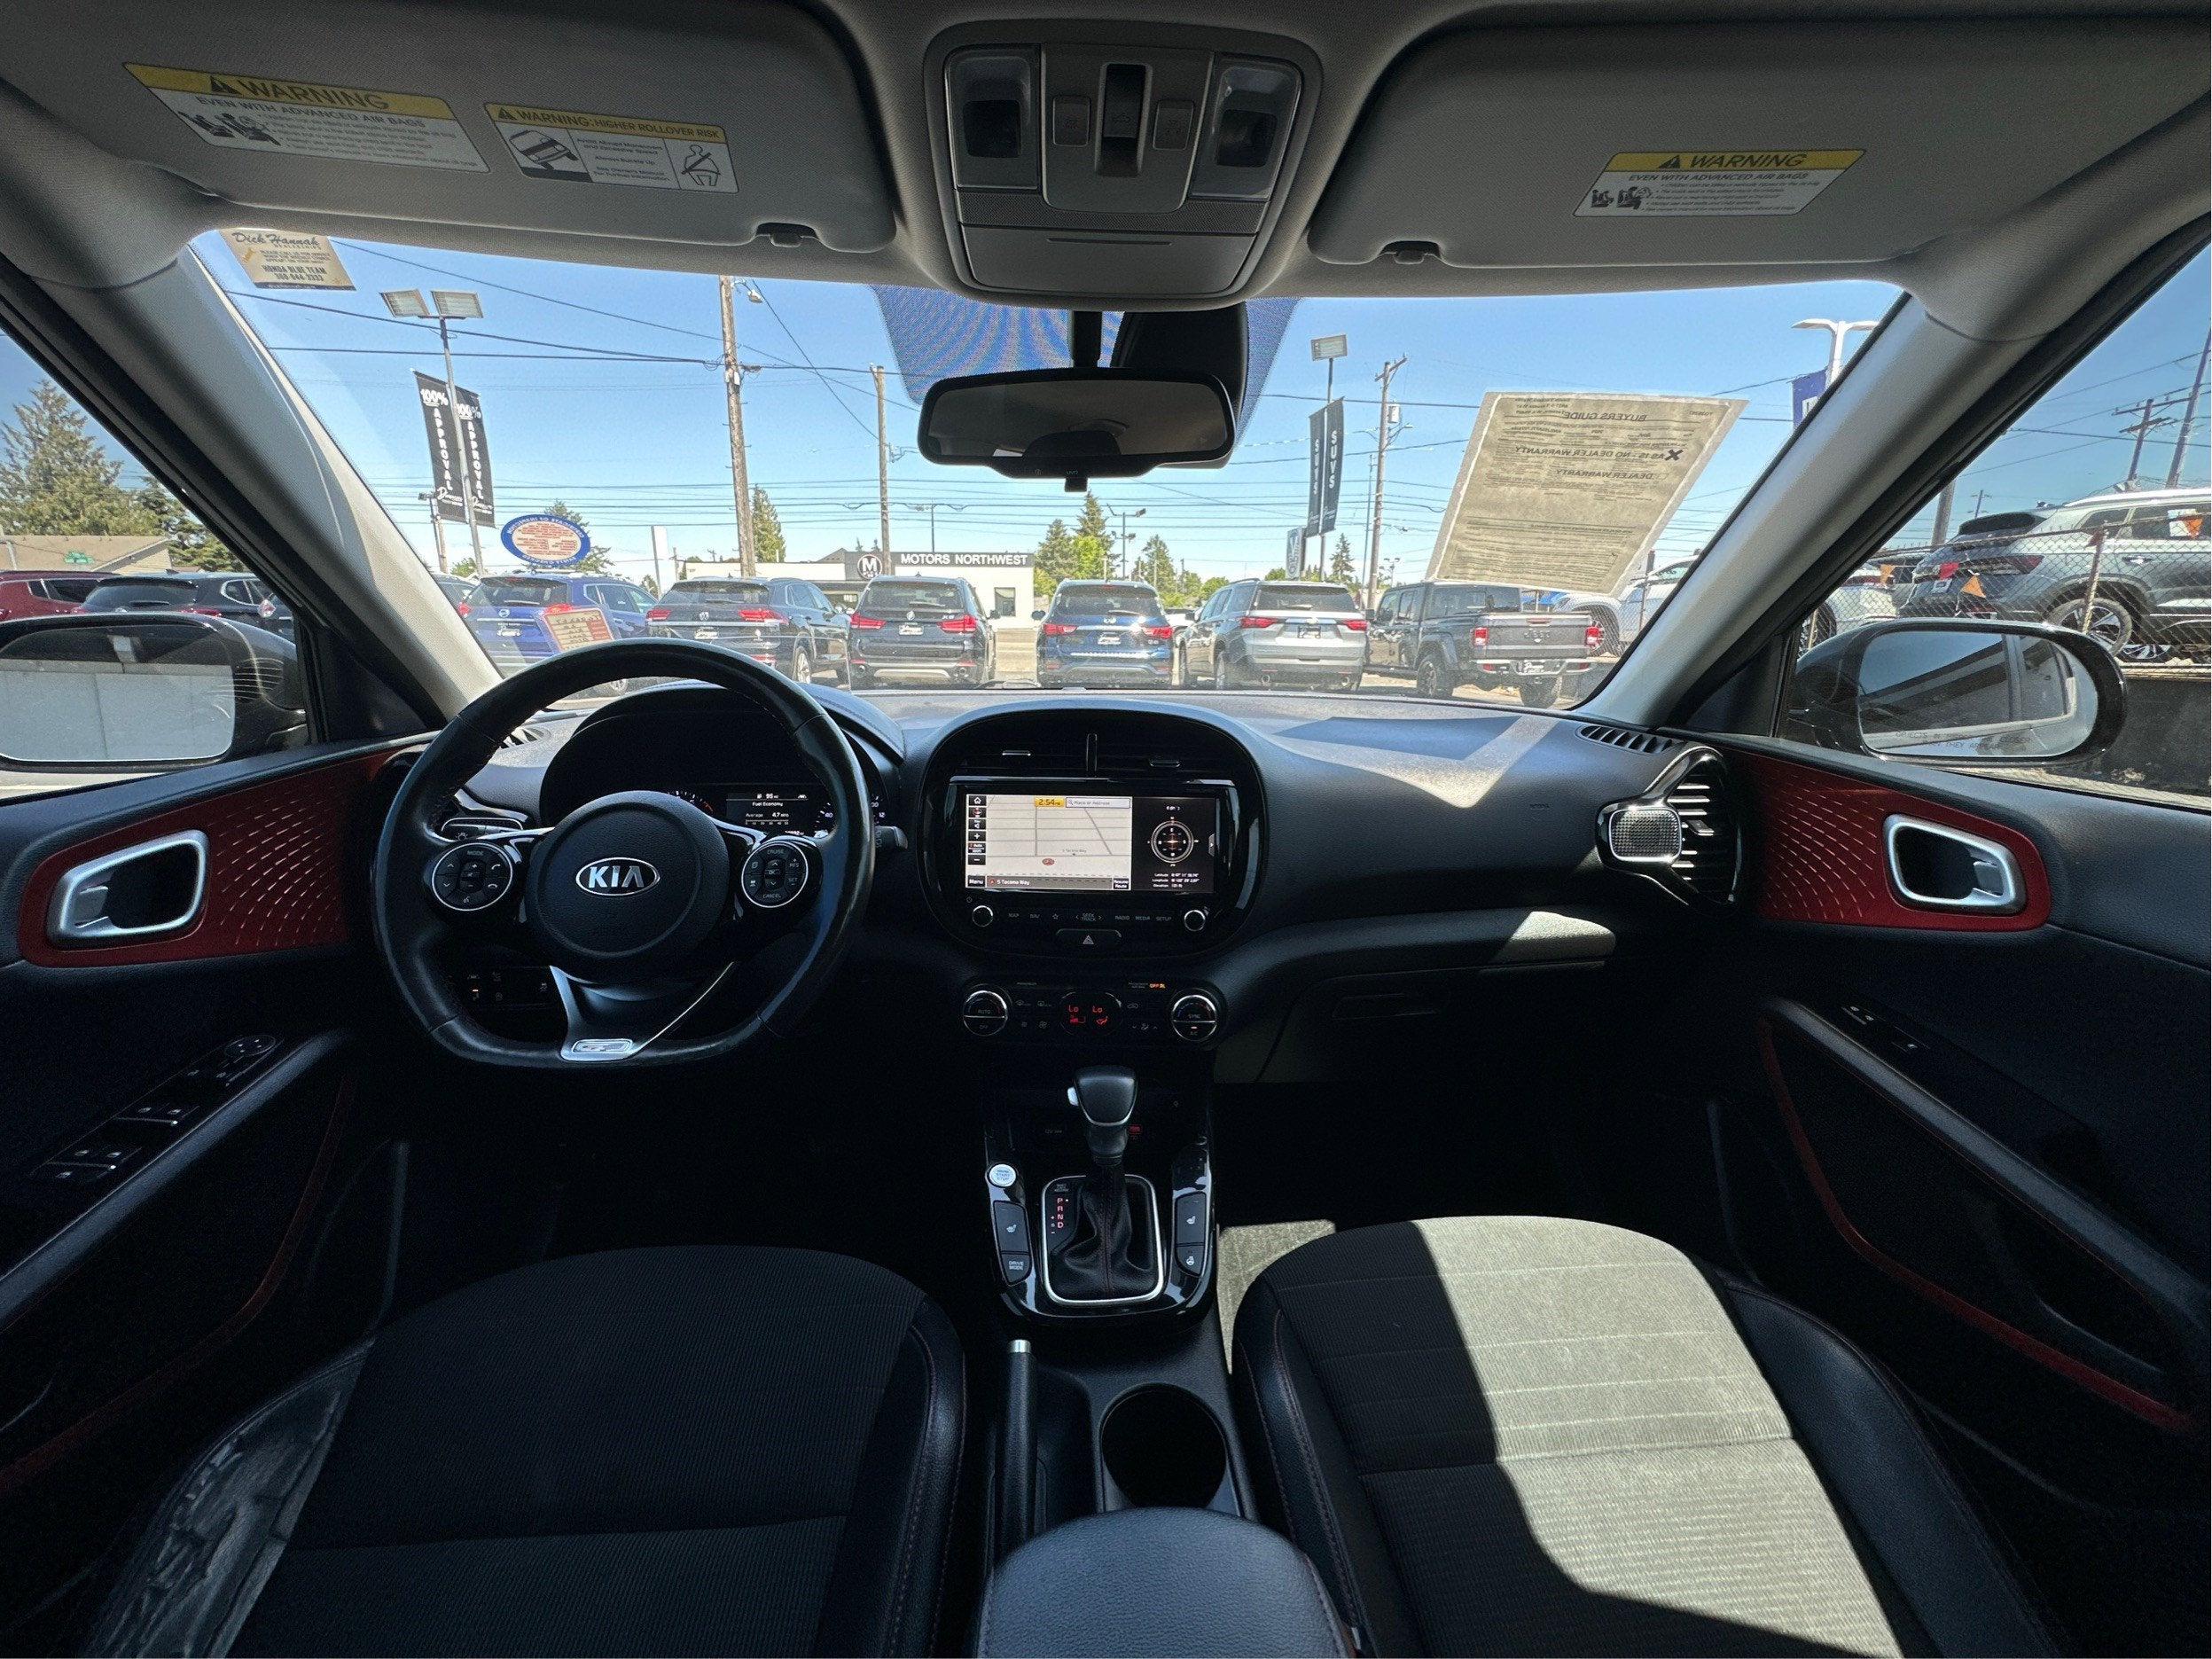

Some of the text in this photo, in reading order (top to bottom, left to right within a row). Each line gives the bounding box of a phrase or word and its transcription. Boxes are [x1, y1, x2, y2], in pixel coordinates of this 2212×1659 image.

[238, 79, 390, 109] WARNING
[195, 97, 426, 128] EVEN WITH ADVANCED AIR BAGS
[516, 110, 720, 138] WARNING: HIGHER ROLLOVER RISK
[1689, 154, 1808, 168] WARNING
[232, 232, 320, 246] Dick Hannah
[420, 388, 449, 406] 100%
[434, 408, 453, 491] APPROVAL
[467, 421, 484, 499] APPROVAL
[862, 556, 878, 572] M
[901, 553, 1028, 567] MOTORS NORTHWEST
[588, 869, 645, 888] KIA
[1068, 1004, 1079, 1013] Lo
